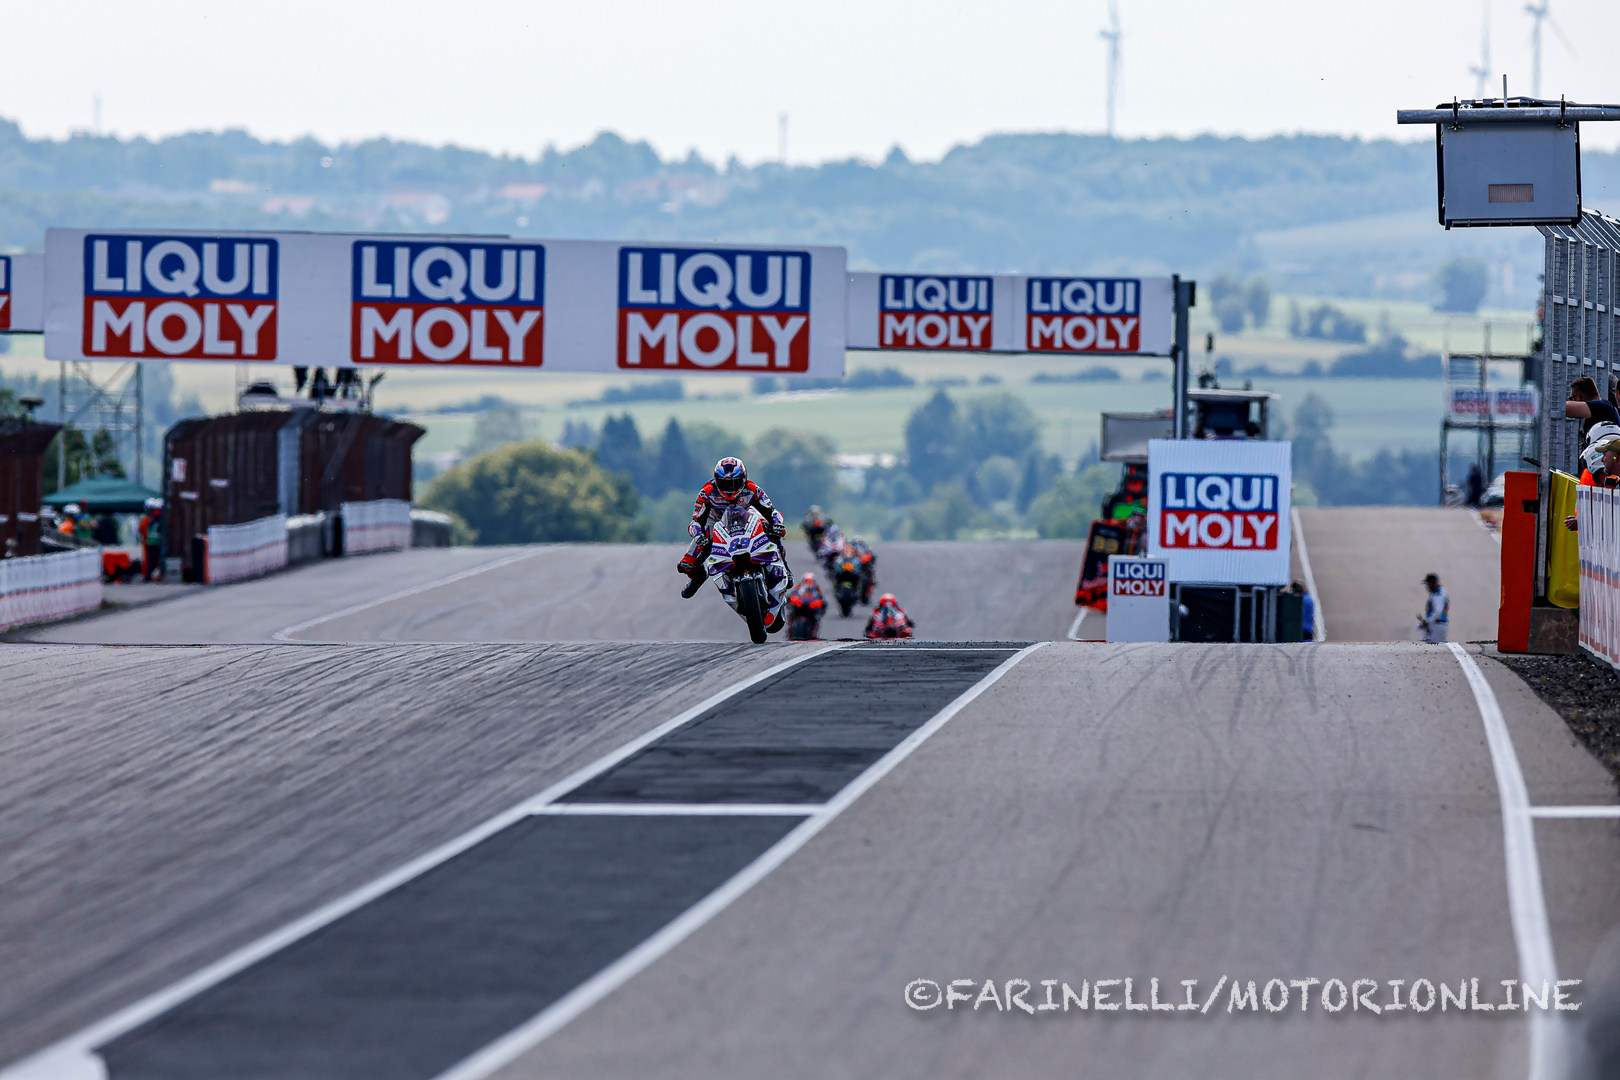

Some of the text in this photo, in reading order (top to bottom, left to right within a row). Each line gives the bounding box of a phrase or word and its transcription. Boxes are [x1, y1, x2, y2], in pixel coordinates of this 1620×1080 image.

[93, 240, 269, 296] LIQUI
[361, 246, 536, 303] LIQUI
[627, 252, 802, 310] LIQUI
[885, 278, 988, 312] LIQUI
[1031, 280, 1136, 314] LIQUI
[92, 300, 274, 355] MOLY
[360, 307, 541, 362] MOLY
[626, 313, 807, 367] MOLY
[884, 314, 990, 348] MOLY
[1031, 316, 1138, 350] MOLY
[1166, 475, 1274, 511] LIQUI
[728, 537, 751, 553] 89
[1165, 513, 1276, 547] MOLY
[1115, 580, 1163, 595] MOLY
[1116, 563, 1163, 580] LIQUI
